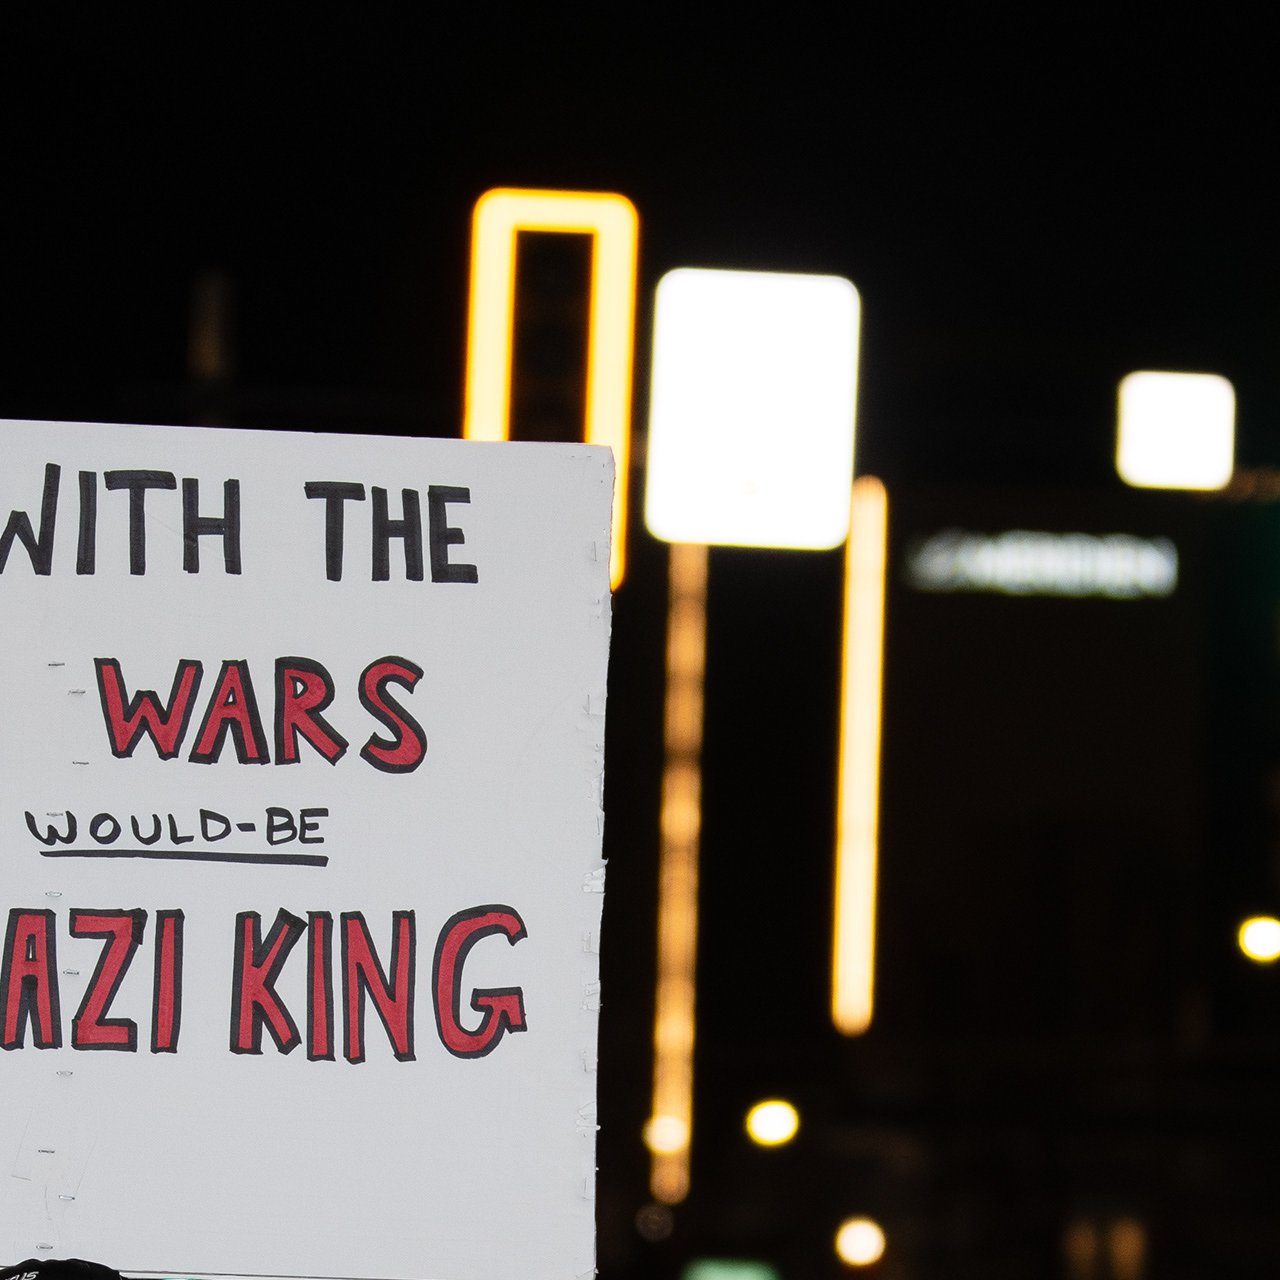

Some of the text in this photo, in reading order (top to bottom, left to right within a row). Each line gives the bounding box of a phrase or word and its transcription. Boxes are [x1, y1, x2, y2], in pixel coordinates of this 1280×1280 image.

[304, 481, 478, 583] THE
[94, 656, 427, 774] WARS
[25, 807, 329, 846] WOULD-BE
[230, 904, 528, 1065] KING
